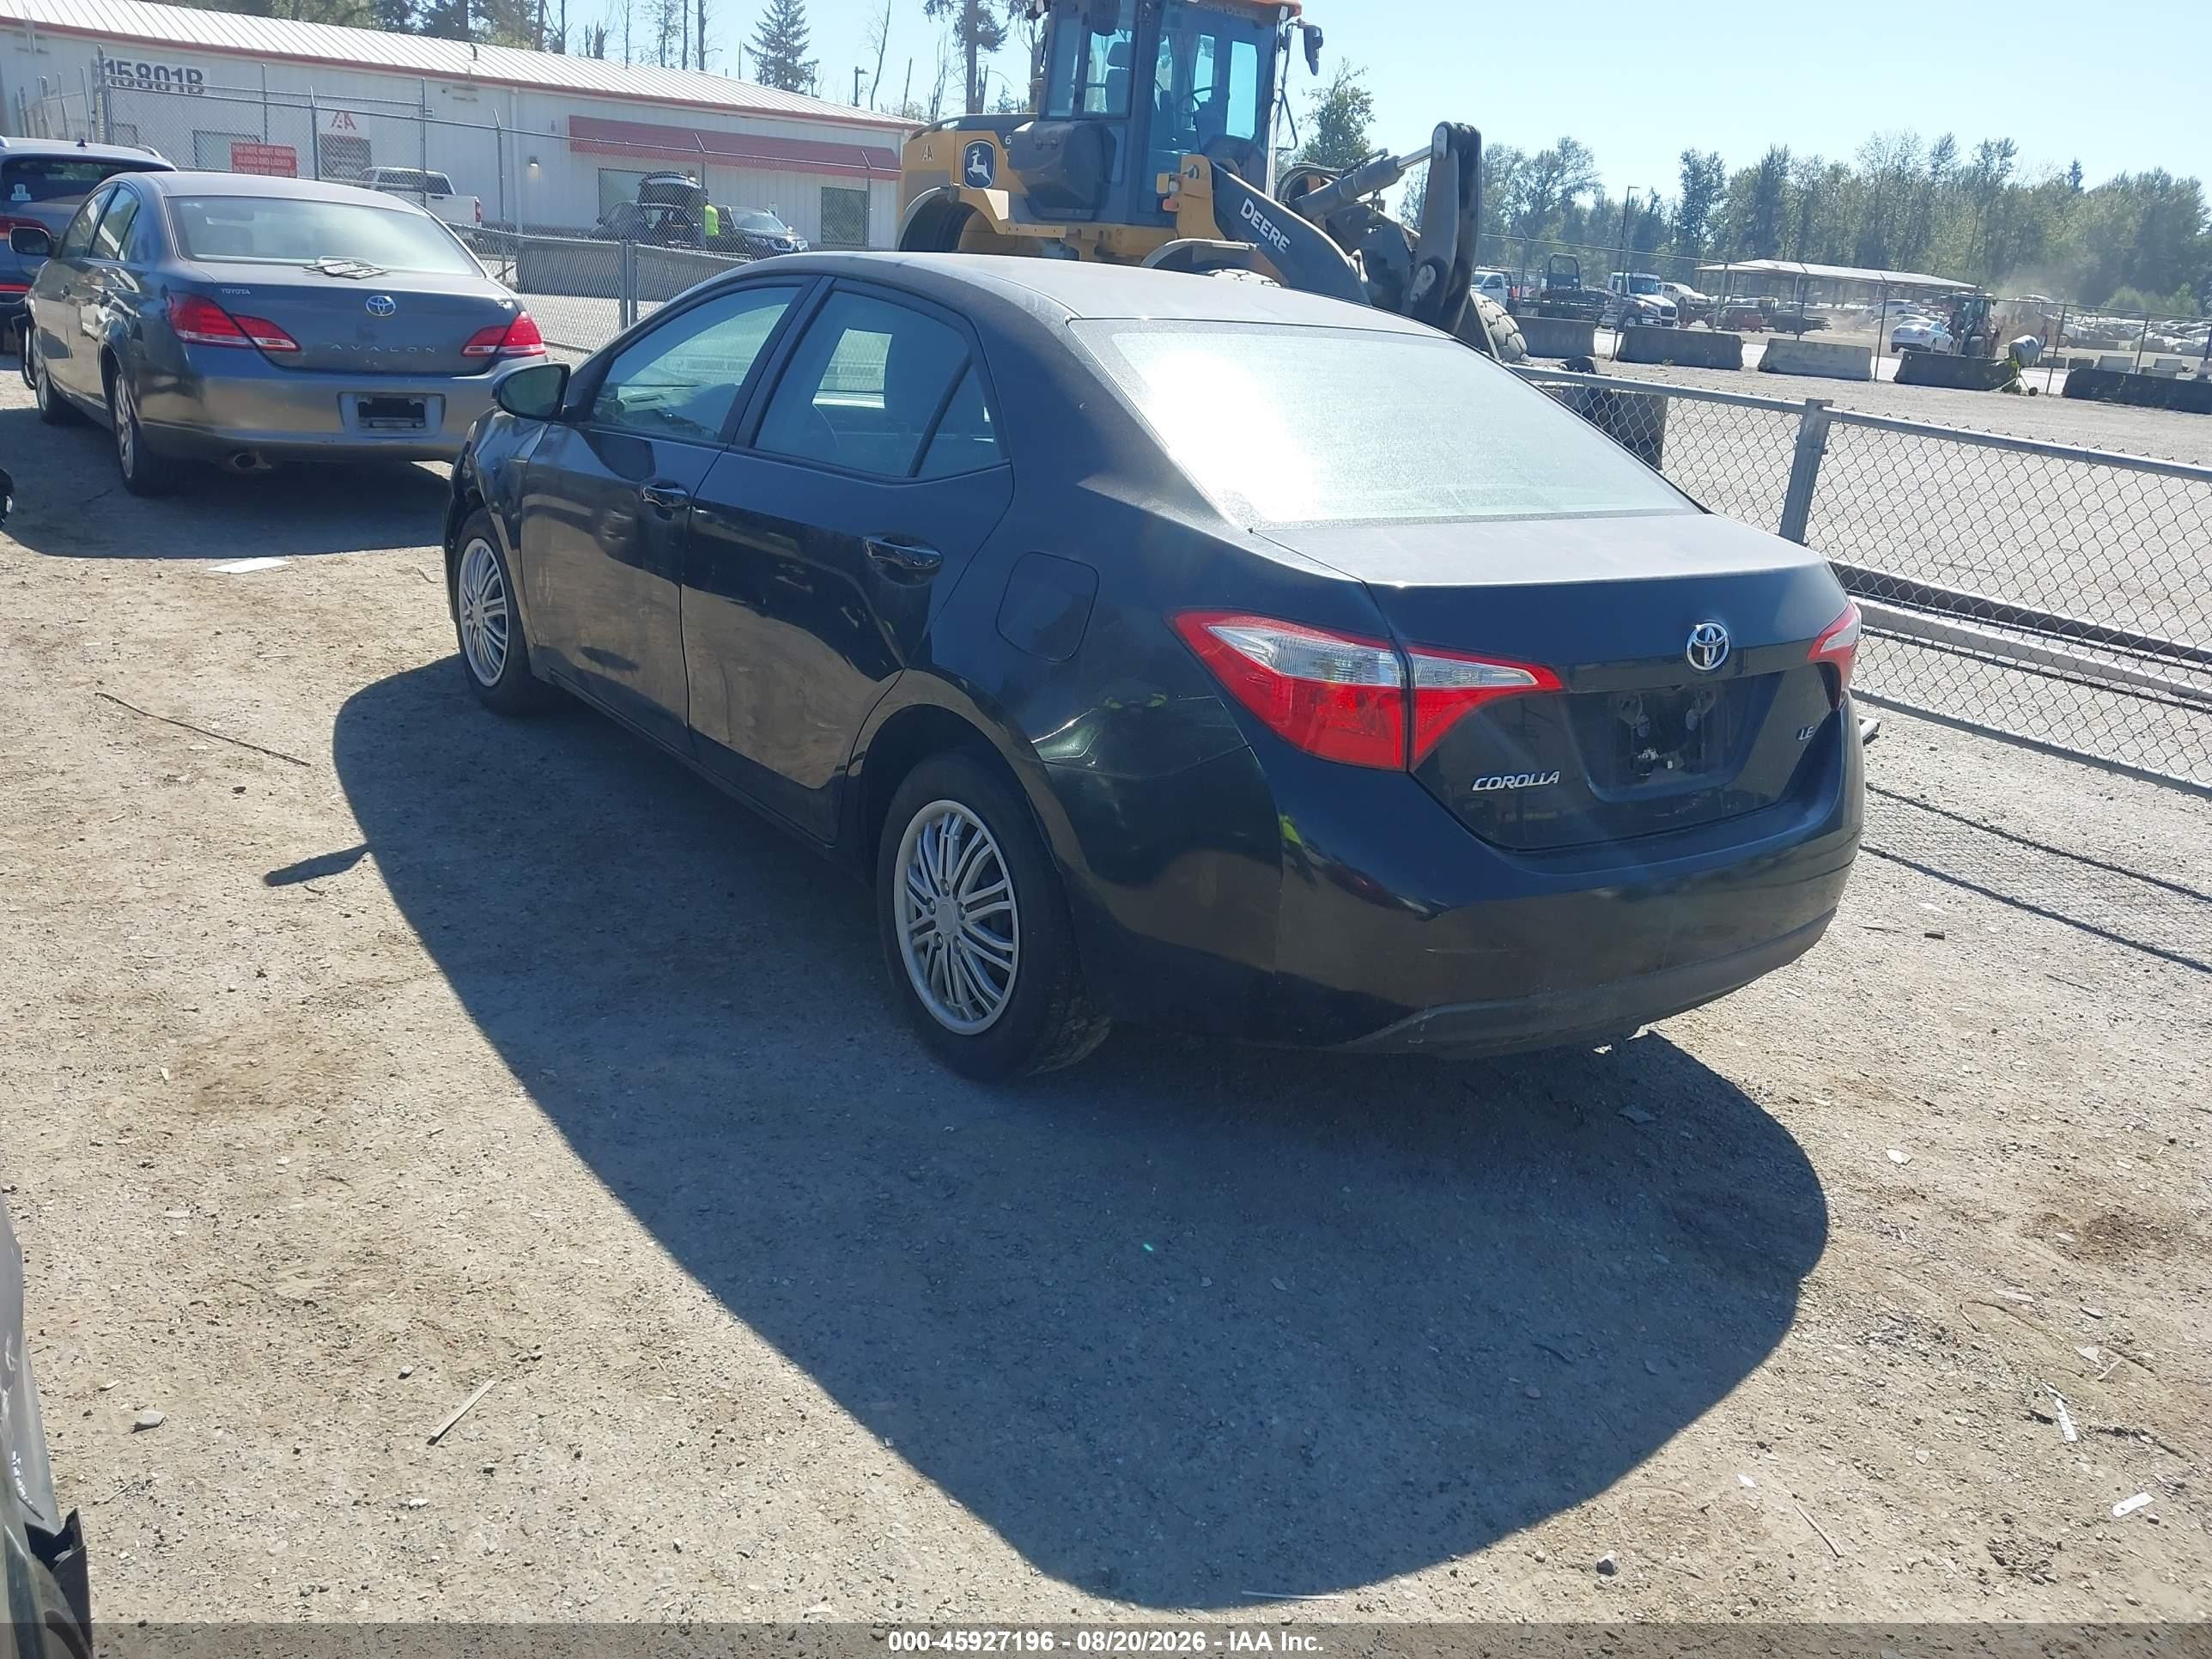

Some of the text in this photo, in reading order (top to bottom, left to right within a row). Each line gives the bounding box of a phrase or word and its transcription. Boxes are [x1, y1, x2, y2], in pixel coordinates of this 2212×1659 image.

[105, 58, 204, 94] 15801B
[1240, 198, 1291, 254] DEERE
[331, 343, 435, 353] AVALON
[1798, 726, 1814, 740] LE
[1472, 770, 1560, 791] COROLLA
